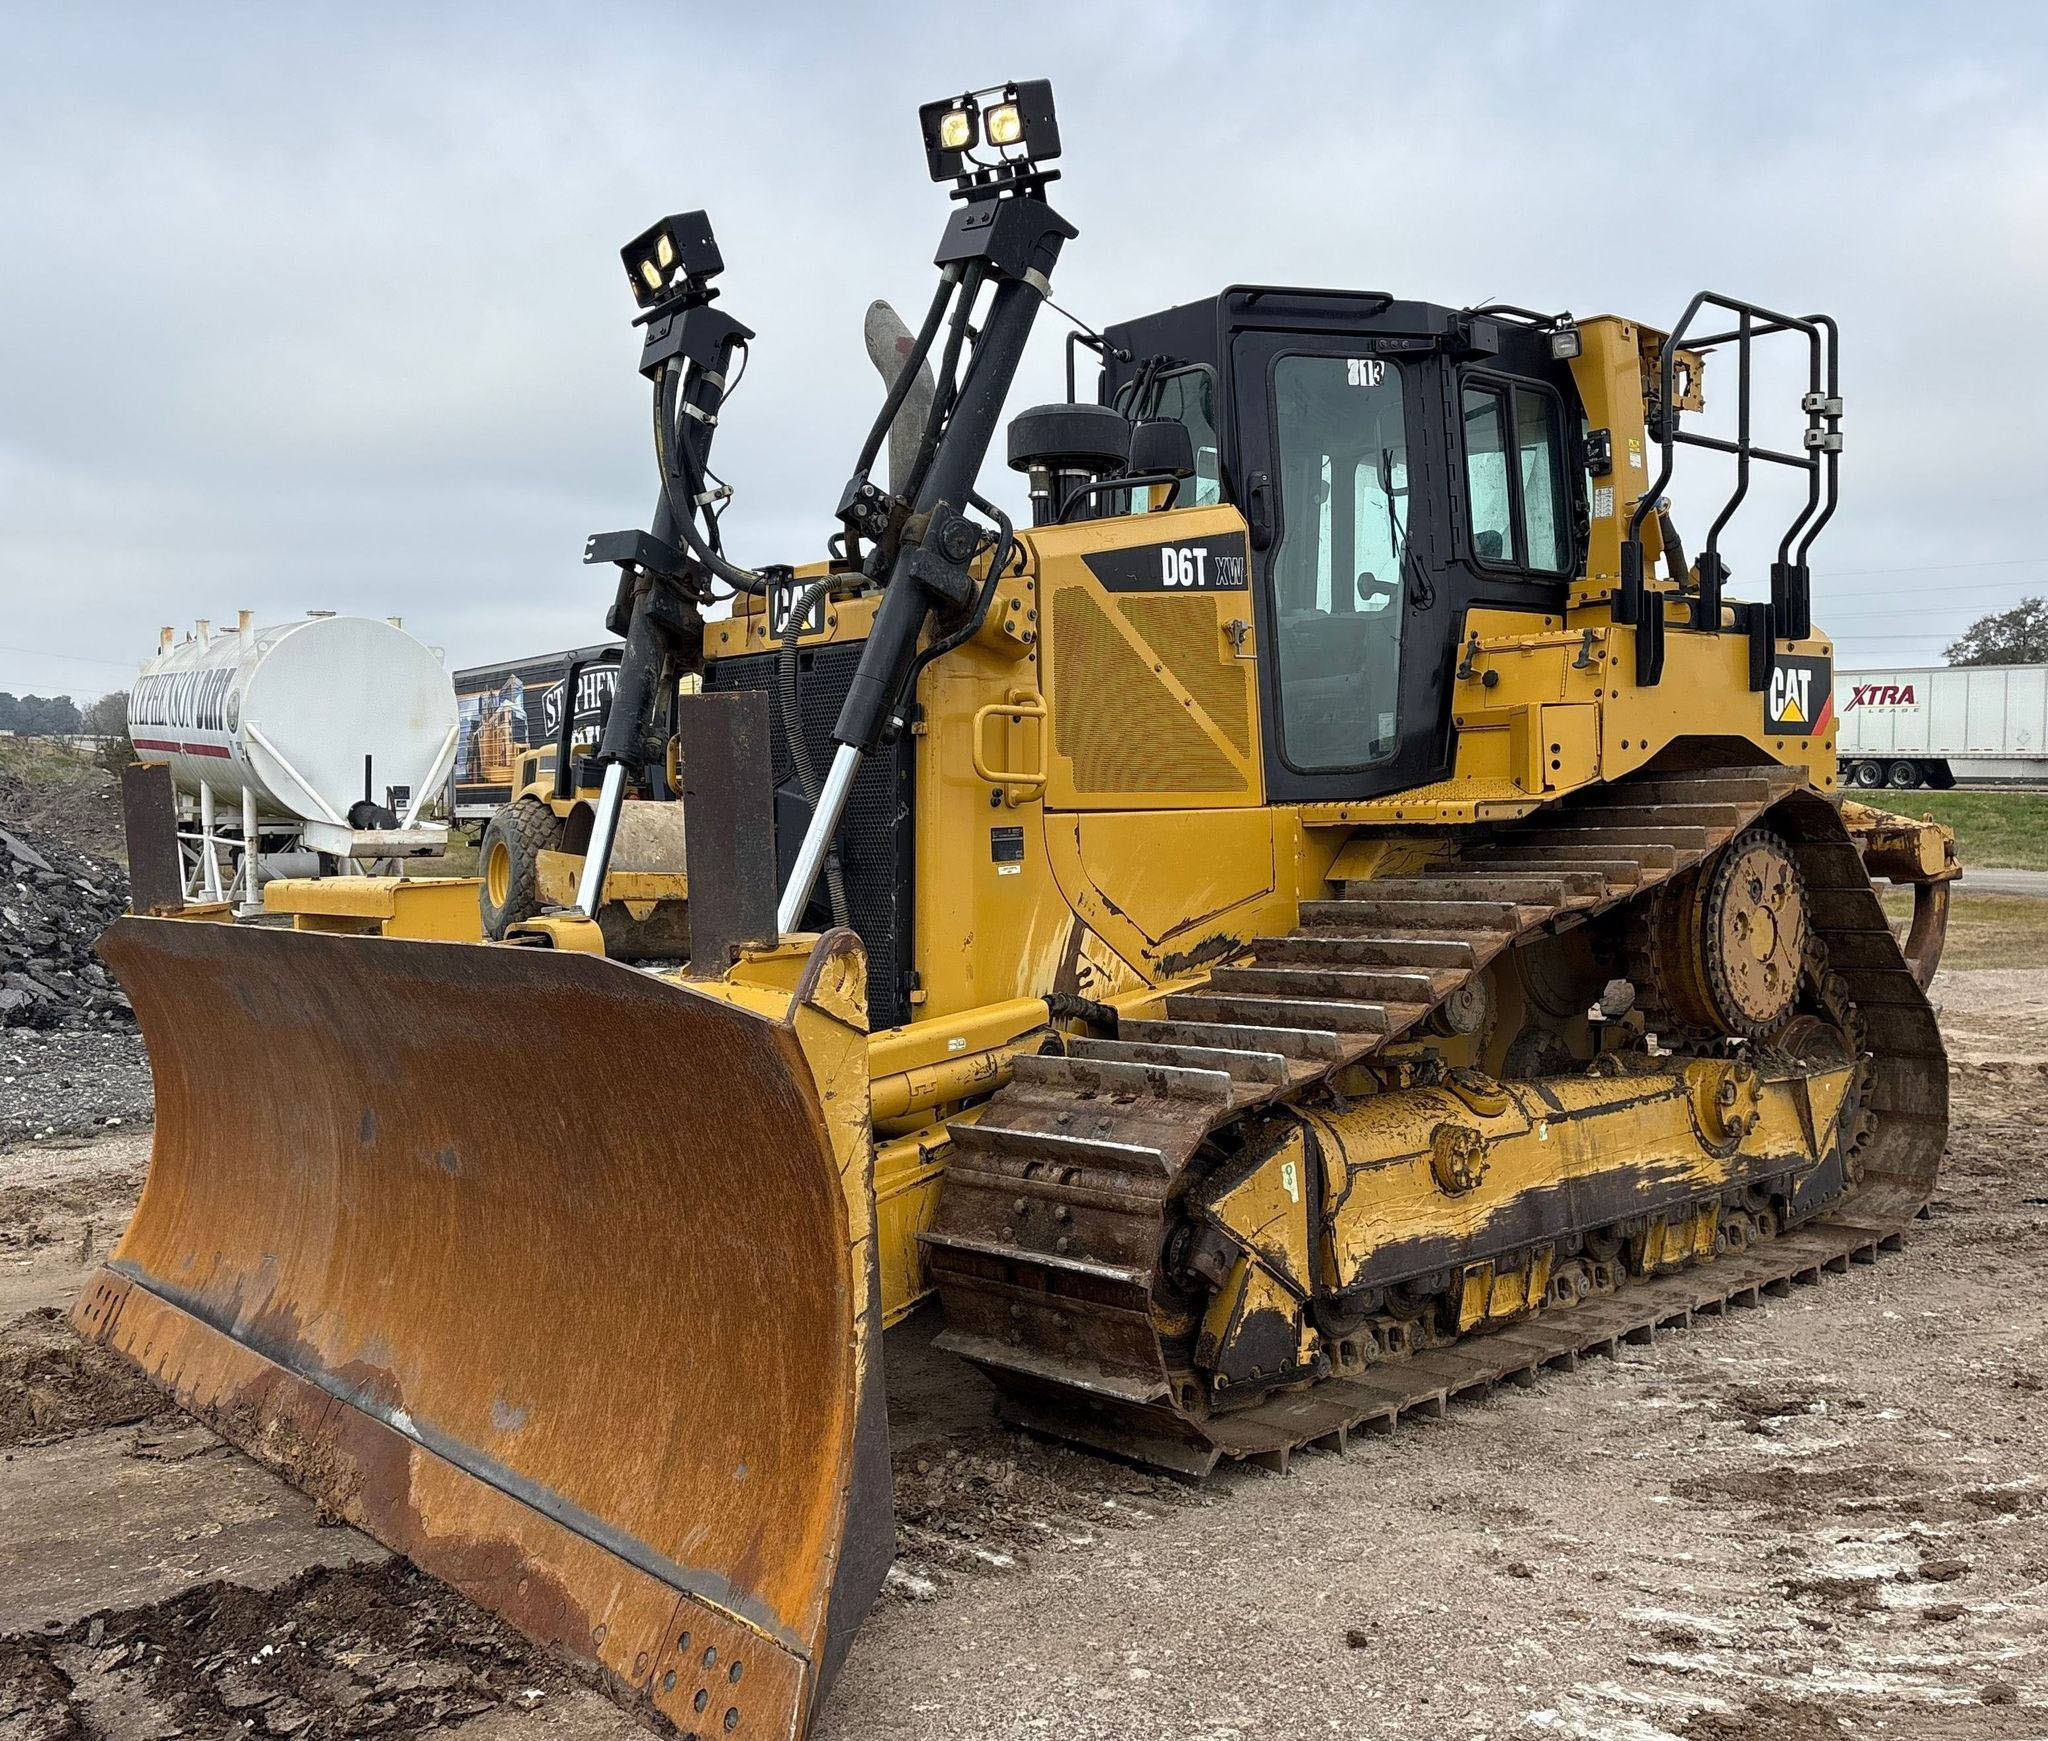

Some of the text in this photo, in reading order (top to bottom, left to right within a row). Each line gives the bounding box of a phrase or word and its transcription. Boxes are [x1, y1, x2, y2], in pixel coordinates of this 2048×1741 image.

[1161, 547, 1244, 587] D6T XW
[1769, 666, 1812, 723] CAT
[1843, 684, 1915, 712] XTRA
